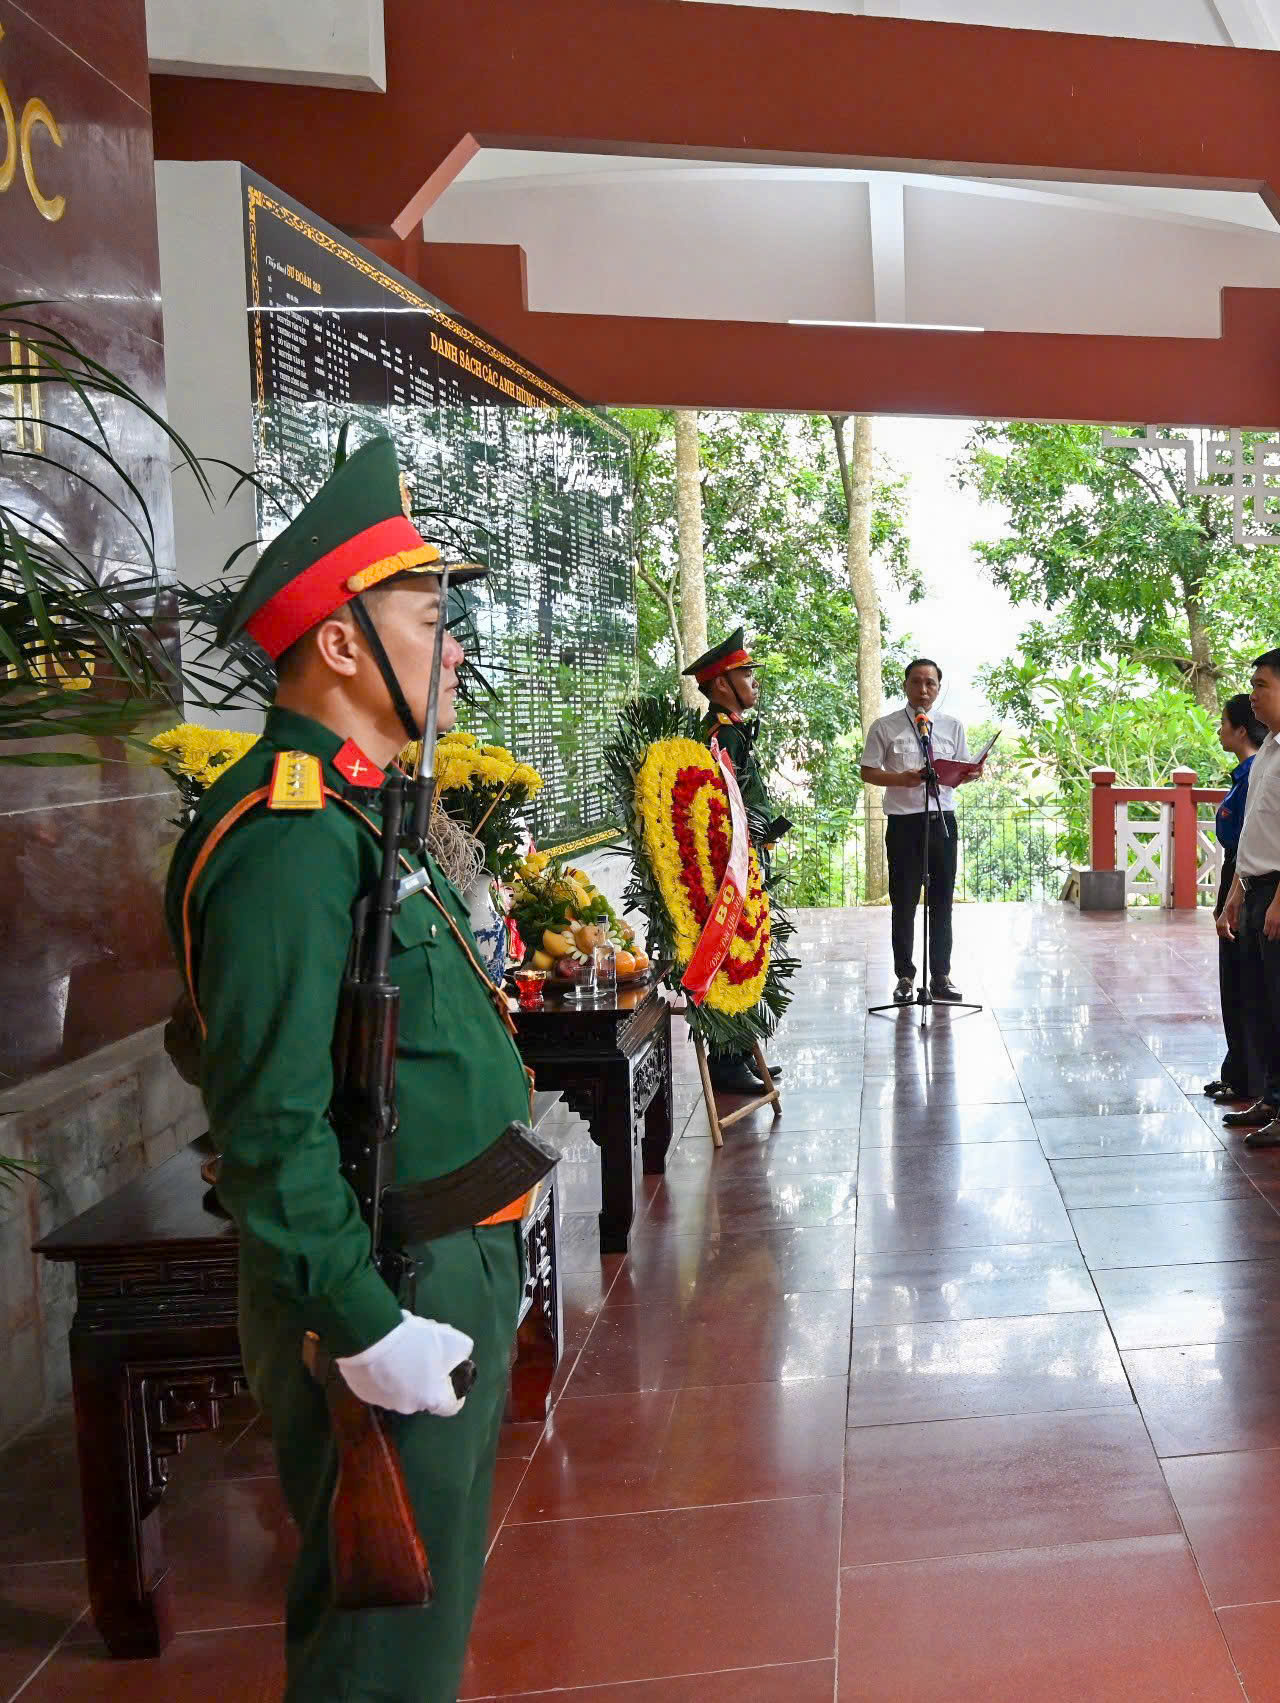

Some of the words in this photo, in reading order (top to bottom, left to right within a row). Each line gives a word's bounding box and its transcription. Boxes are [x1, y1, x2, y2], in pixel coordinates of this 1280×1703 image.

[430, 331, 458, 365] DANH
[460, 349, 482, 378] SÁCH
[482, 363, 499, 388] CÁC
[499, 375, 515, 397] ANH
[715, 885, 735, 925] BỘ
